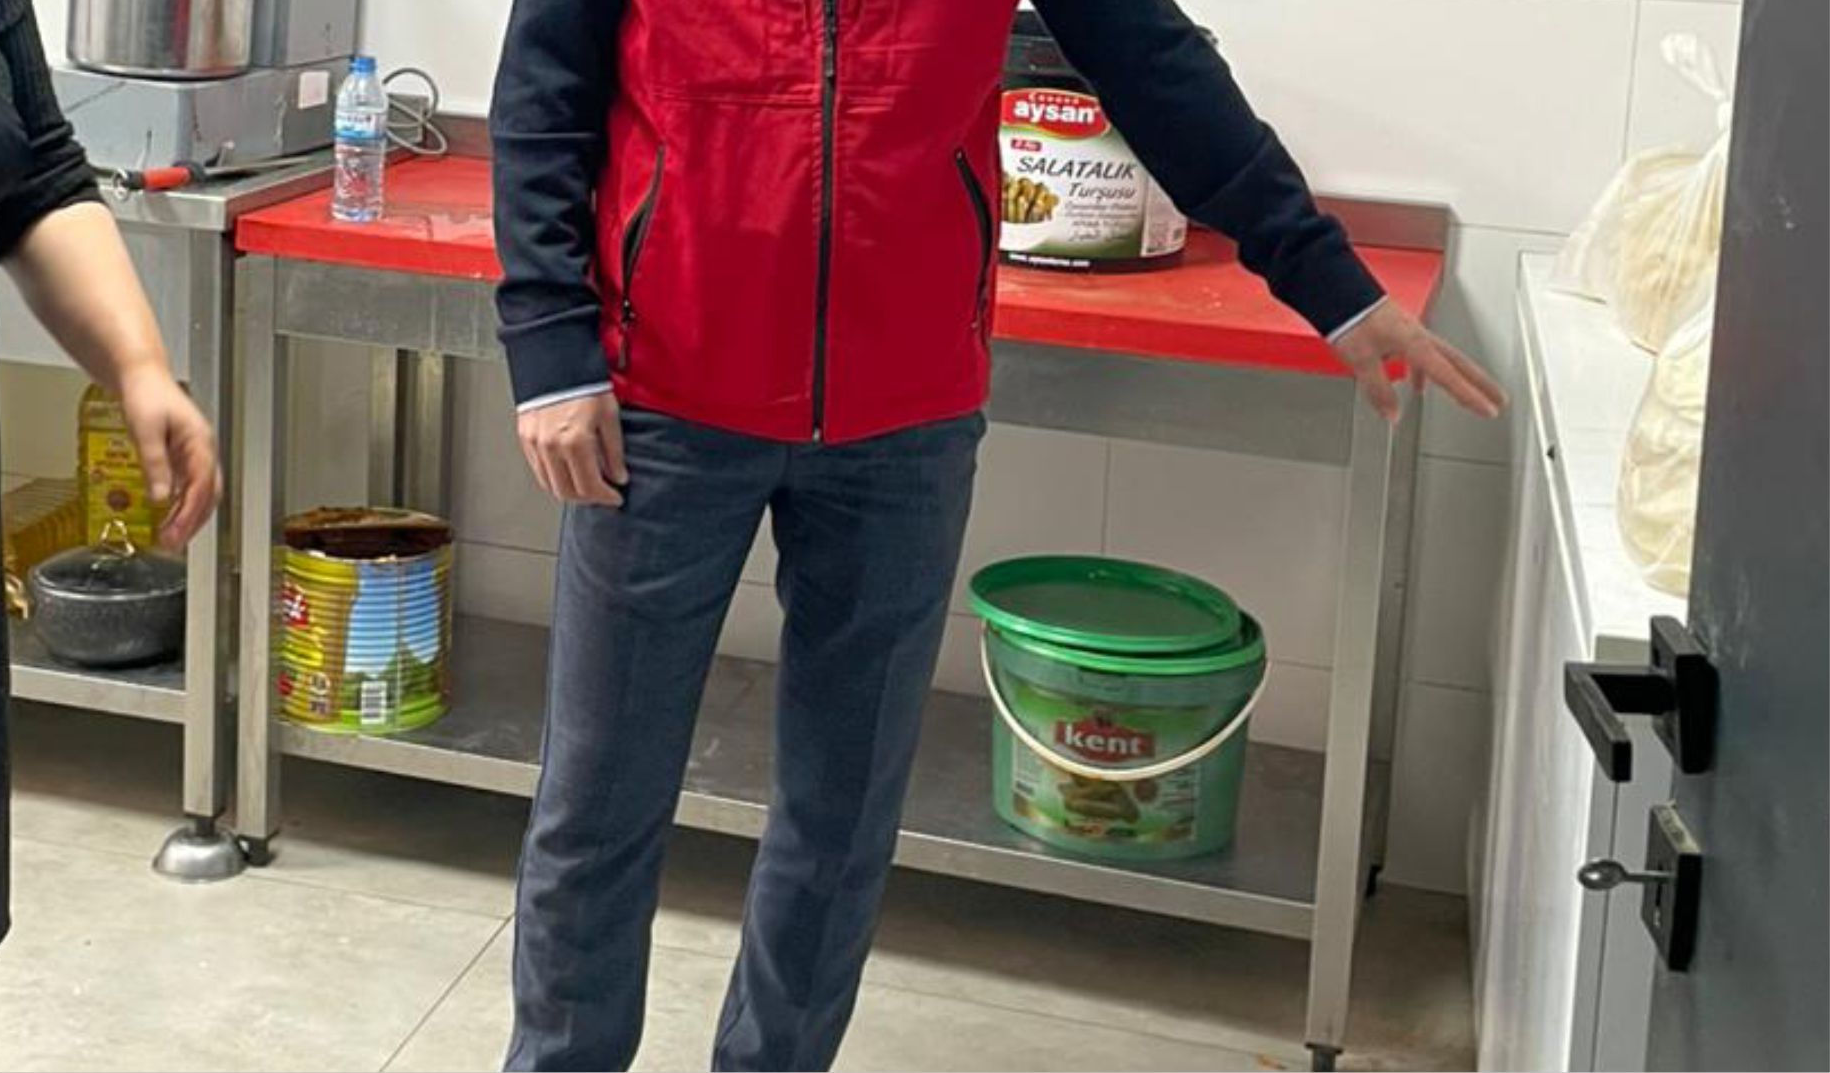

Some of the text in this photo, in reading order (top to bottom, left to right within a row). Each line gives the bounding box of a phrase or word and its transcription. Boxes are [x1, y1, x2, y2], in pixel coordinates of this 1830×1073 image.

[1014, 98, 1096, 124] aysan
[1017, 156, 1138, 179] SALATALIK
[1064, 725, 1144, 756] kent
